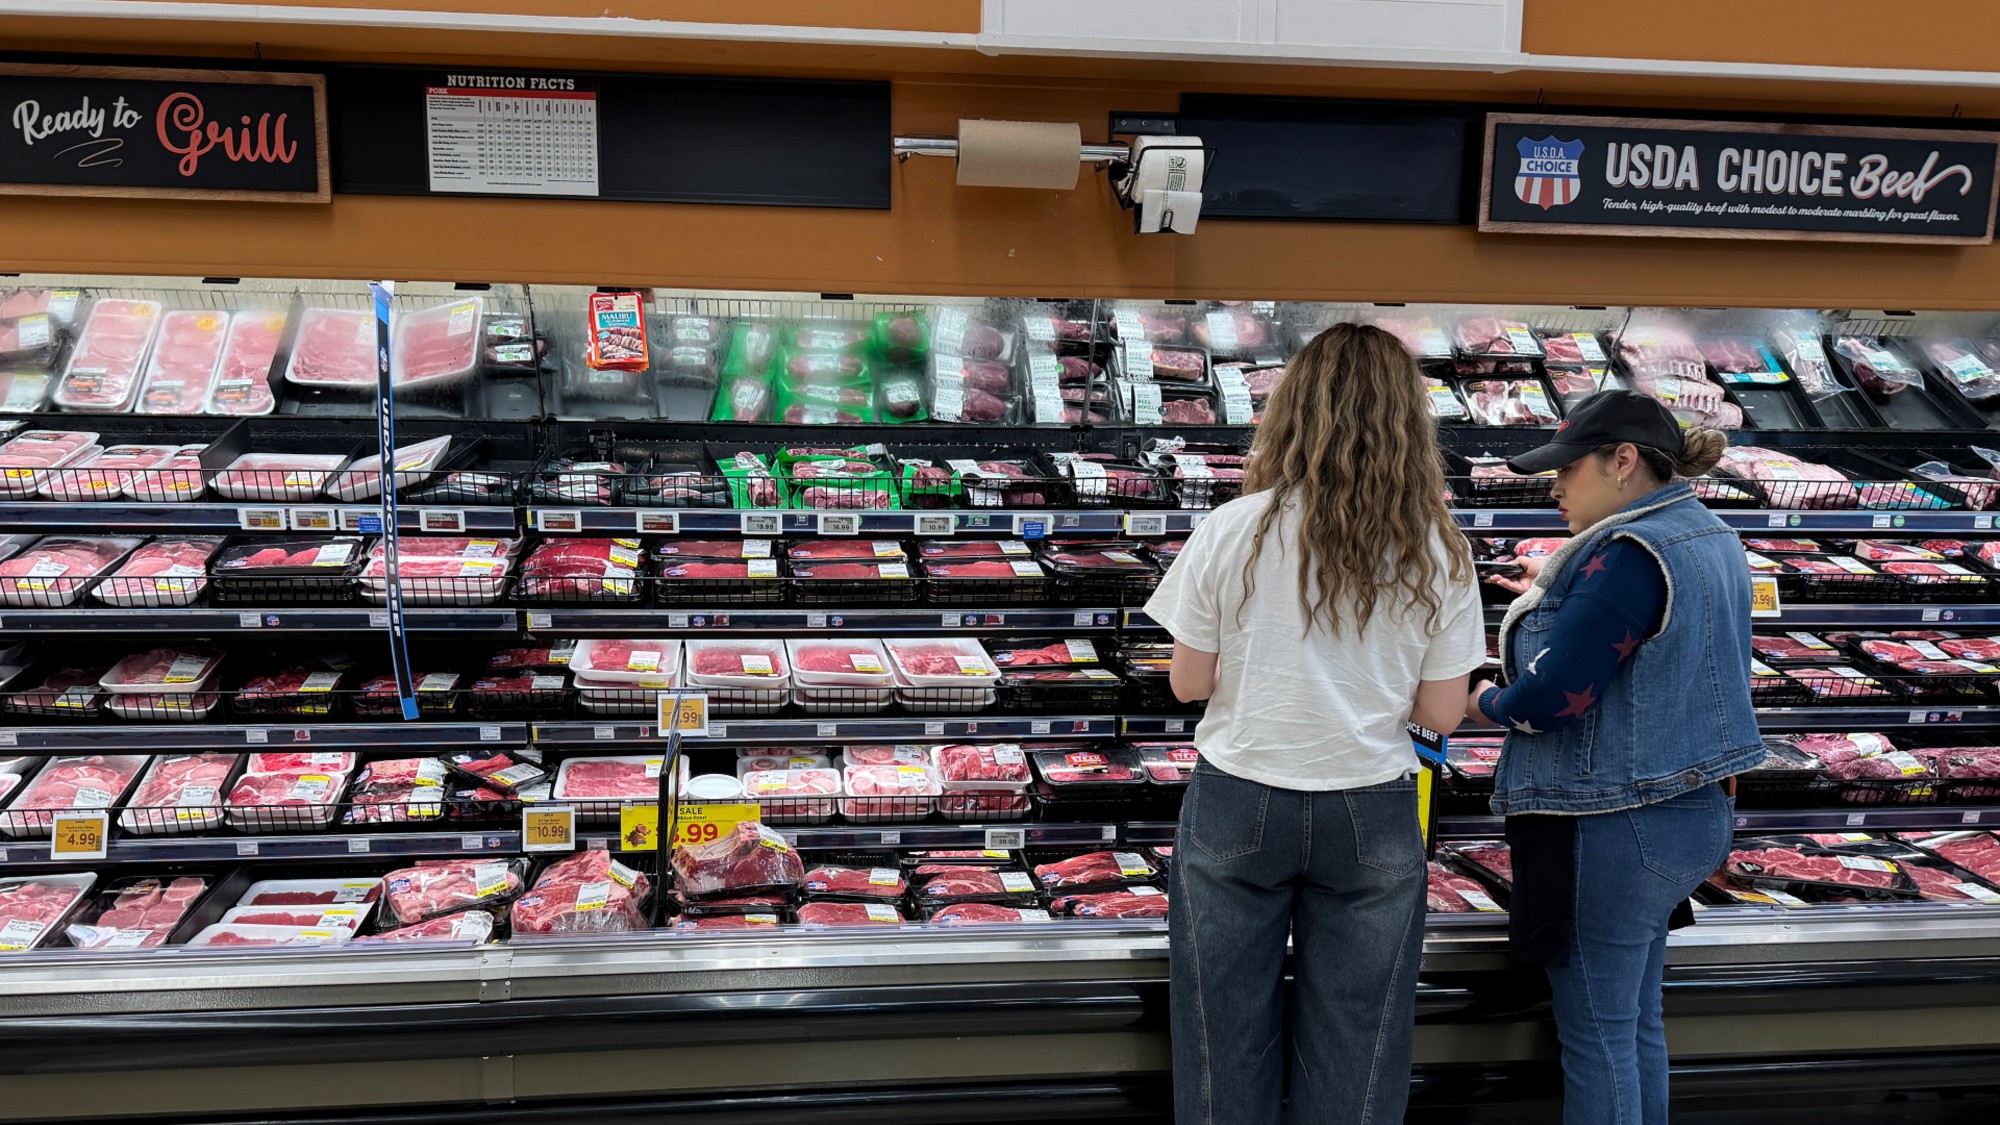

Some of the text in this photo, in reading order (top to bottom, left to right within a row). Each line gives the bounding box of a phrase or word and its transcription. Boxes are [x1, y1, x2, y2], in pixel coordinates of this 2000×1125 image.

[447, 75, 575, 90] NUTRITION FACTS
[13, 96, 142, 146] Ready to
[156, 92, 298, 176] Grill
[1533, 146, 1566, 159] U.S.D.A.
[1526, 160, 1572, 172] CHOICE
[1606, 142, 1973, 204] USDA CHOICE Beef
[1602, 198, 1960, 222] Tender, high-quality beef with modest to moderate marbling for great flavor.
[601, 313, 632, 321] MALIBU
[382, 397, 401, 637] USDA CHOICE BEEF
[1422, 727, 1438, 743] BEEF
[67, 833, 96, 845] 4.99
[538, 826, 564, 838] 10.99
